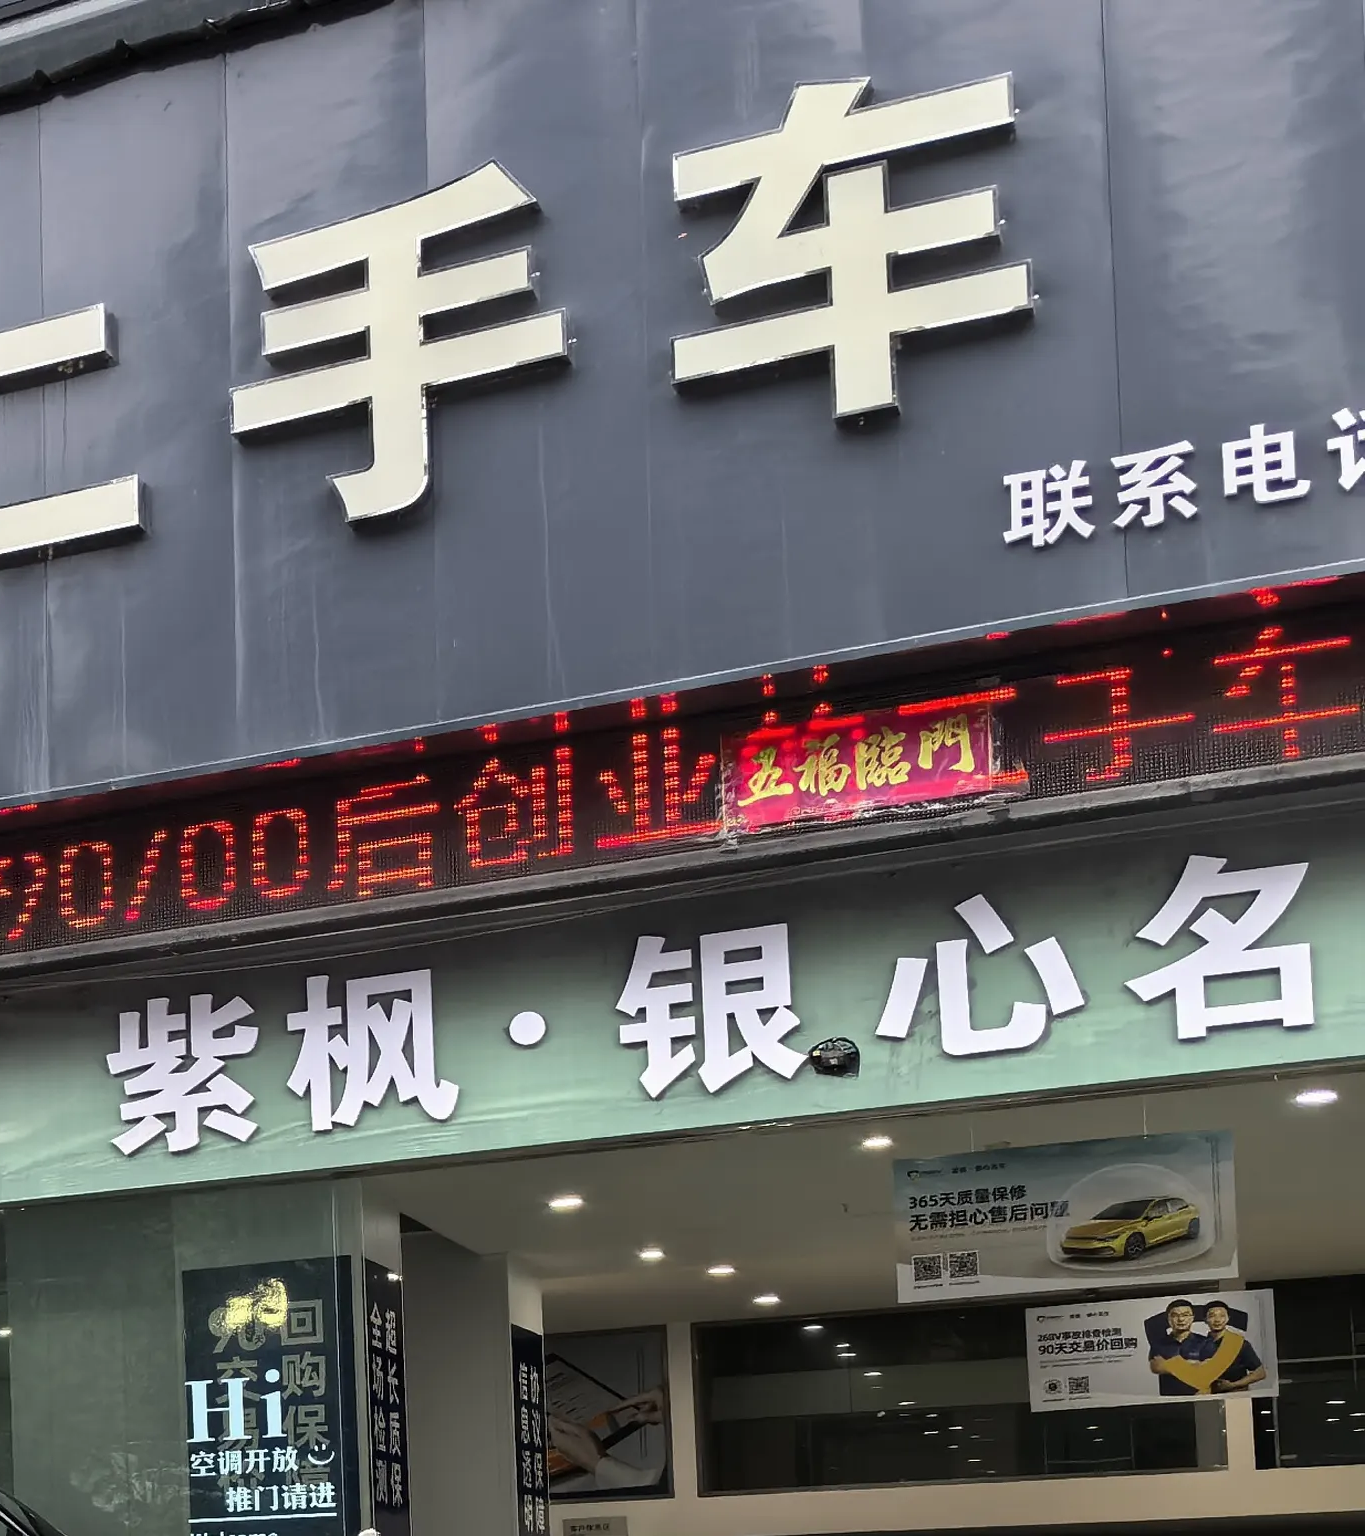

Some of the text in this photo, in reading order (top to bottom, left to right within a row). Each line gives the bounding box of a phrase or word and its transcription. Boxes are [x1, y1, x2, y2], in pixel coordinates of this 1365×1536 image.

[909, 1184, 1027, 1210] 365天质量保修
[909, 1200, 1070, 1232] 无需担心售后问题
[1038, 1337, 1139, 1356] 90天交易价回购
[185, 1368, 288, 1443] Hi
[190, 1446, 300, 1478] 空调开放
[226, 1482, 338, 1513] 推门请进
